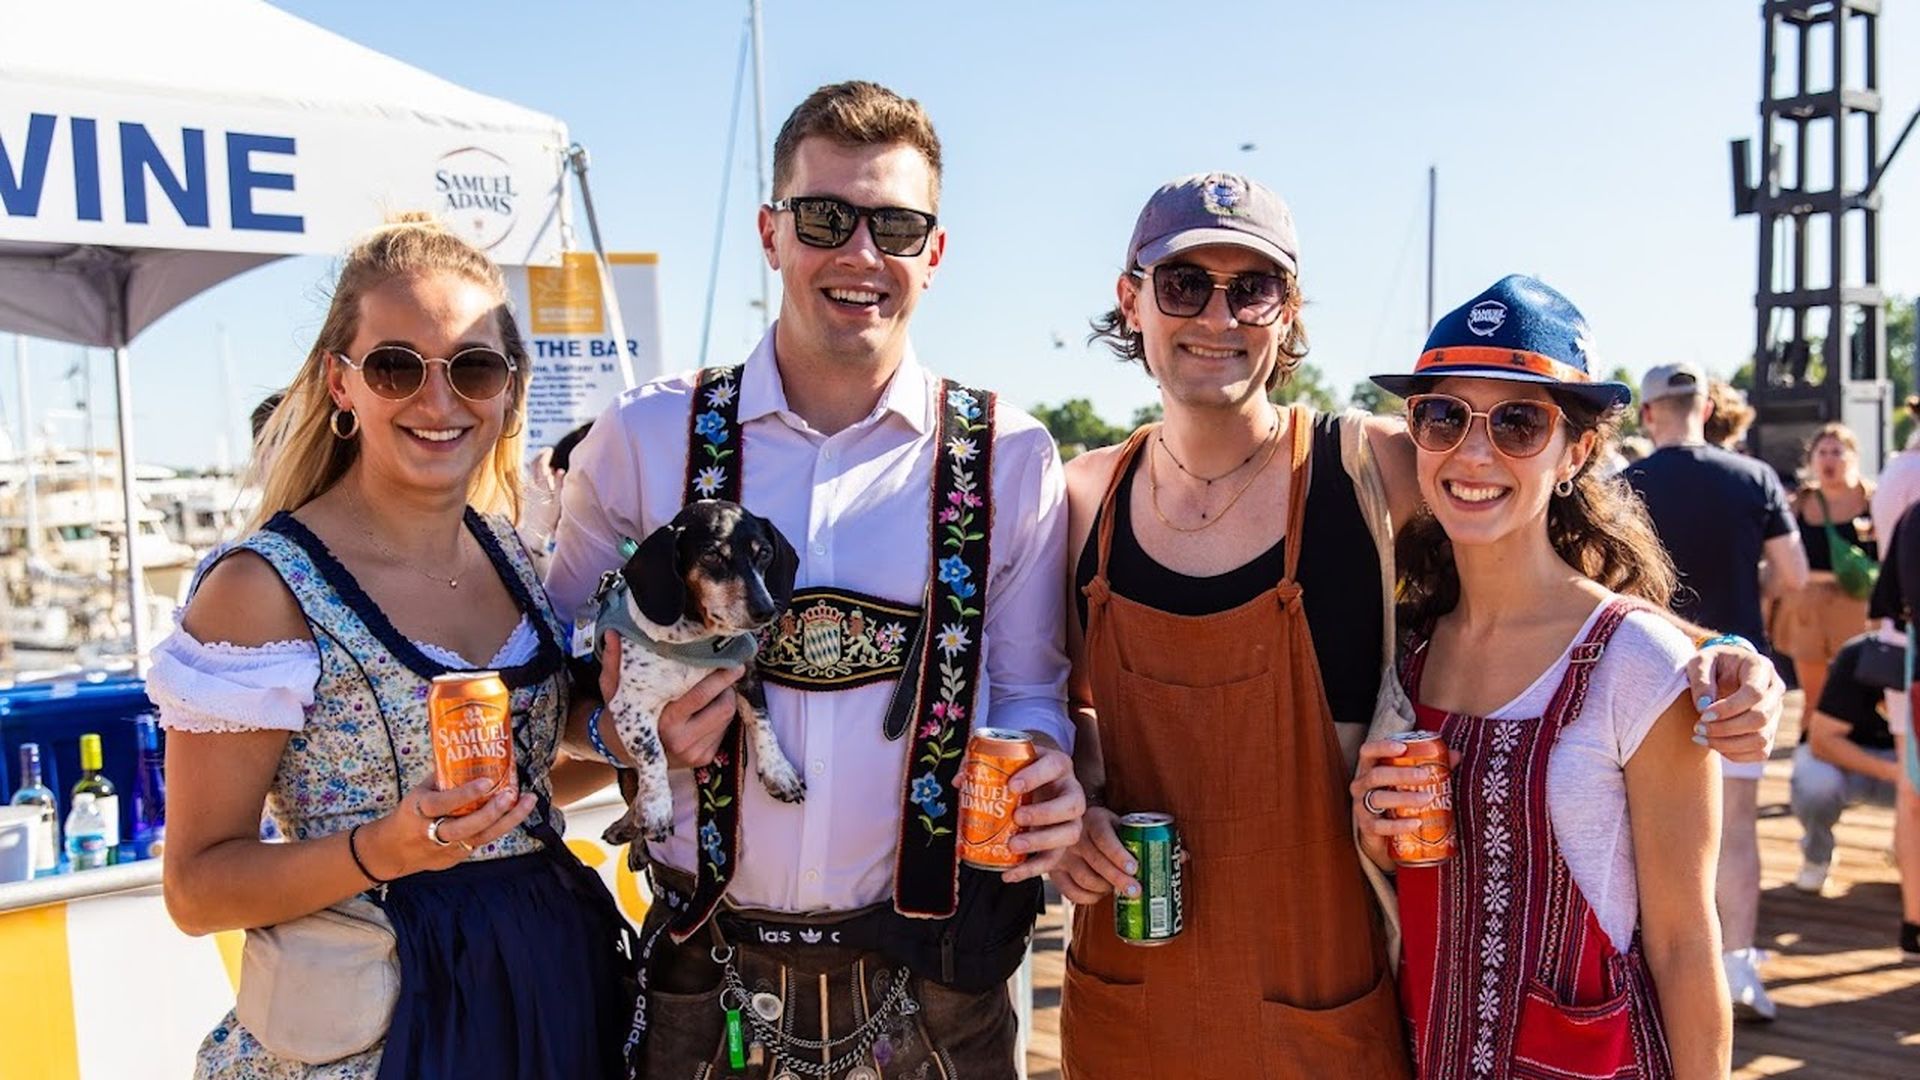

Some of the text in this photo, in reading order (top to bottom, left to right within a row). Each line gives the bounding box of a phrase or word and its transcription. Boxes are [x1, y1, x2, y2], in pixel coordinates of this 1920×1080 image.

[436, 170, 519, 197] SAMUEL
[445, 193, 512, 216] ADAMS
[1470, 308, 1506, 319] SAMUEL
[534, 339, 639, 358] THE BAR
[438, 721, 510, 749] SAMUEL
[445, 739, 507, 762] ADAMS
[622, 994, 648, 1064] adida
